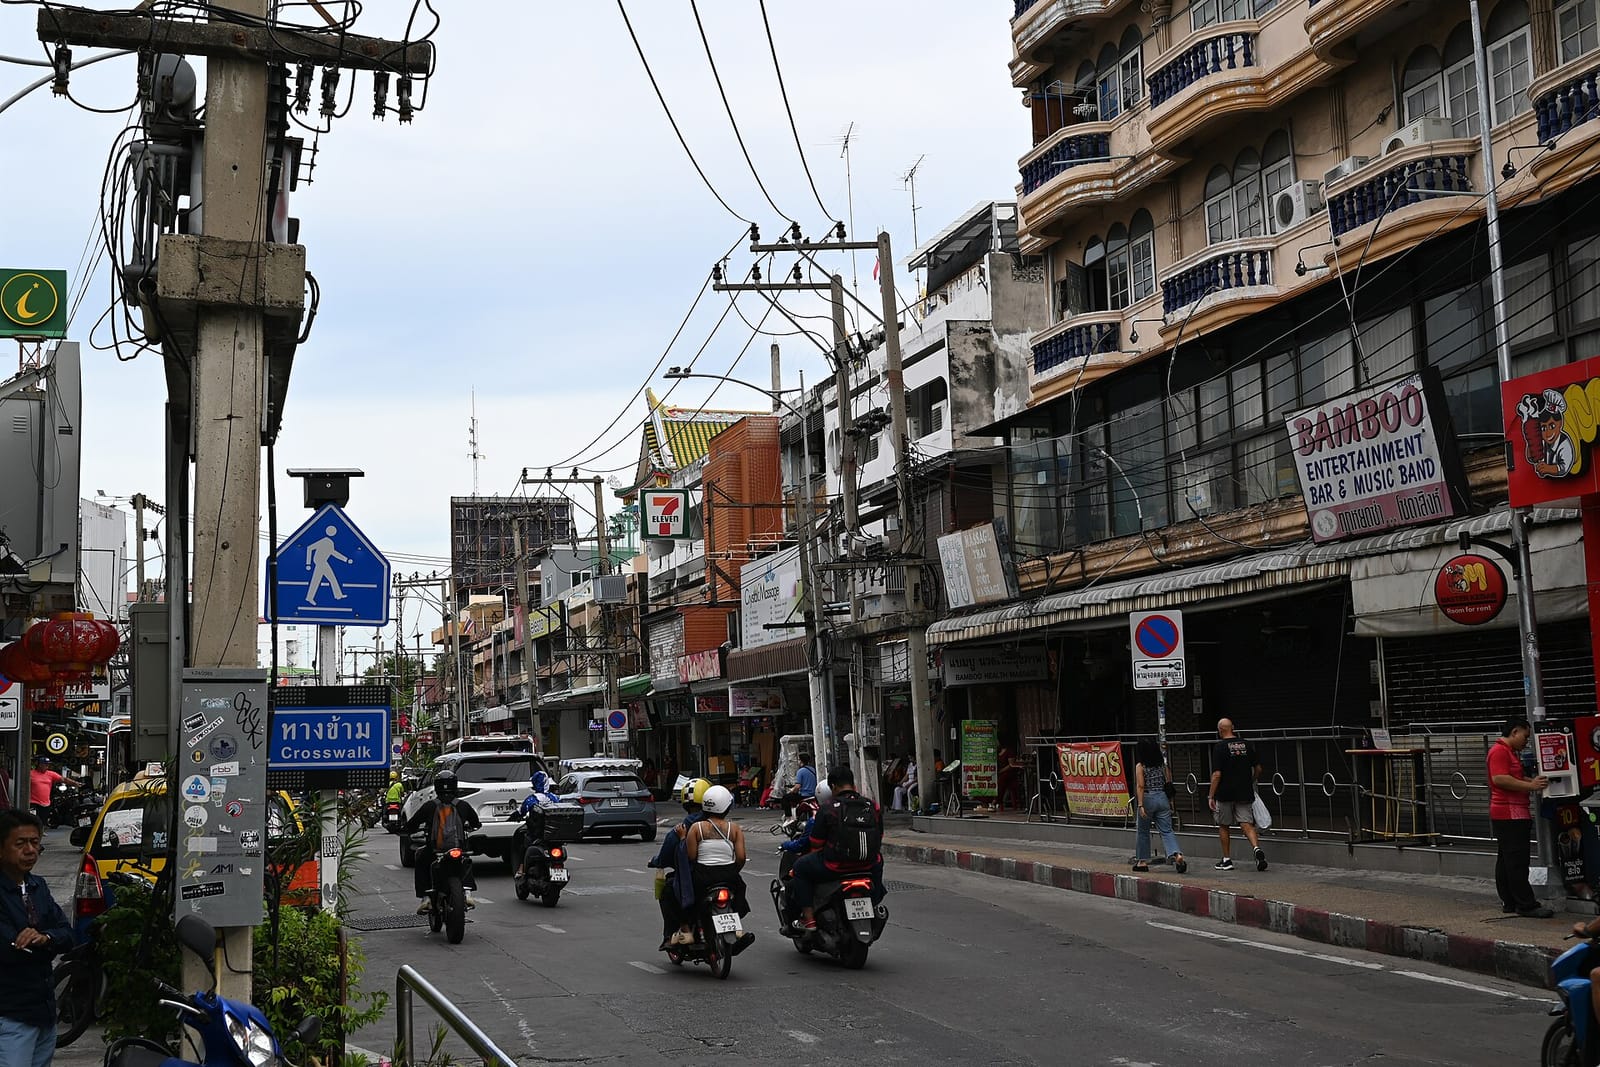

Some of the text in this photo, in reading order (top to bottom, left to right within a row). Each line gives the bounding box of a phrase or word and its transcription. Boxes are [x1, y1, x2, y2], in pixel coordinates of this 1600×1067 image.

[1293, 384, 1424, 456] BAMBOO
[1305, 432, 1424, 482] ENTERTAINMENT
[1309, 458, 1435, 505] BAR & MUSIC BAND
[653, 496, 679, 535] 7
[956, 673, 982, 681] BAMBOO
[984, 671, 1008, 680] HEALTH
[281, 715, 371, 740] ทางข้าม
[281, 746, 371, 759] Crosswalk
[210, 864, 233, 873] AMI
